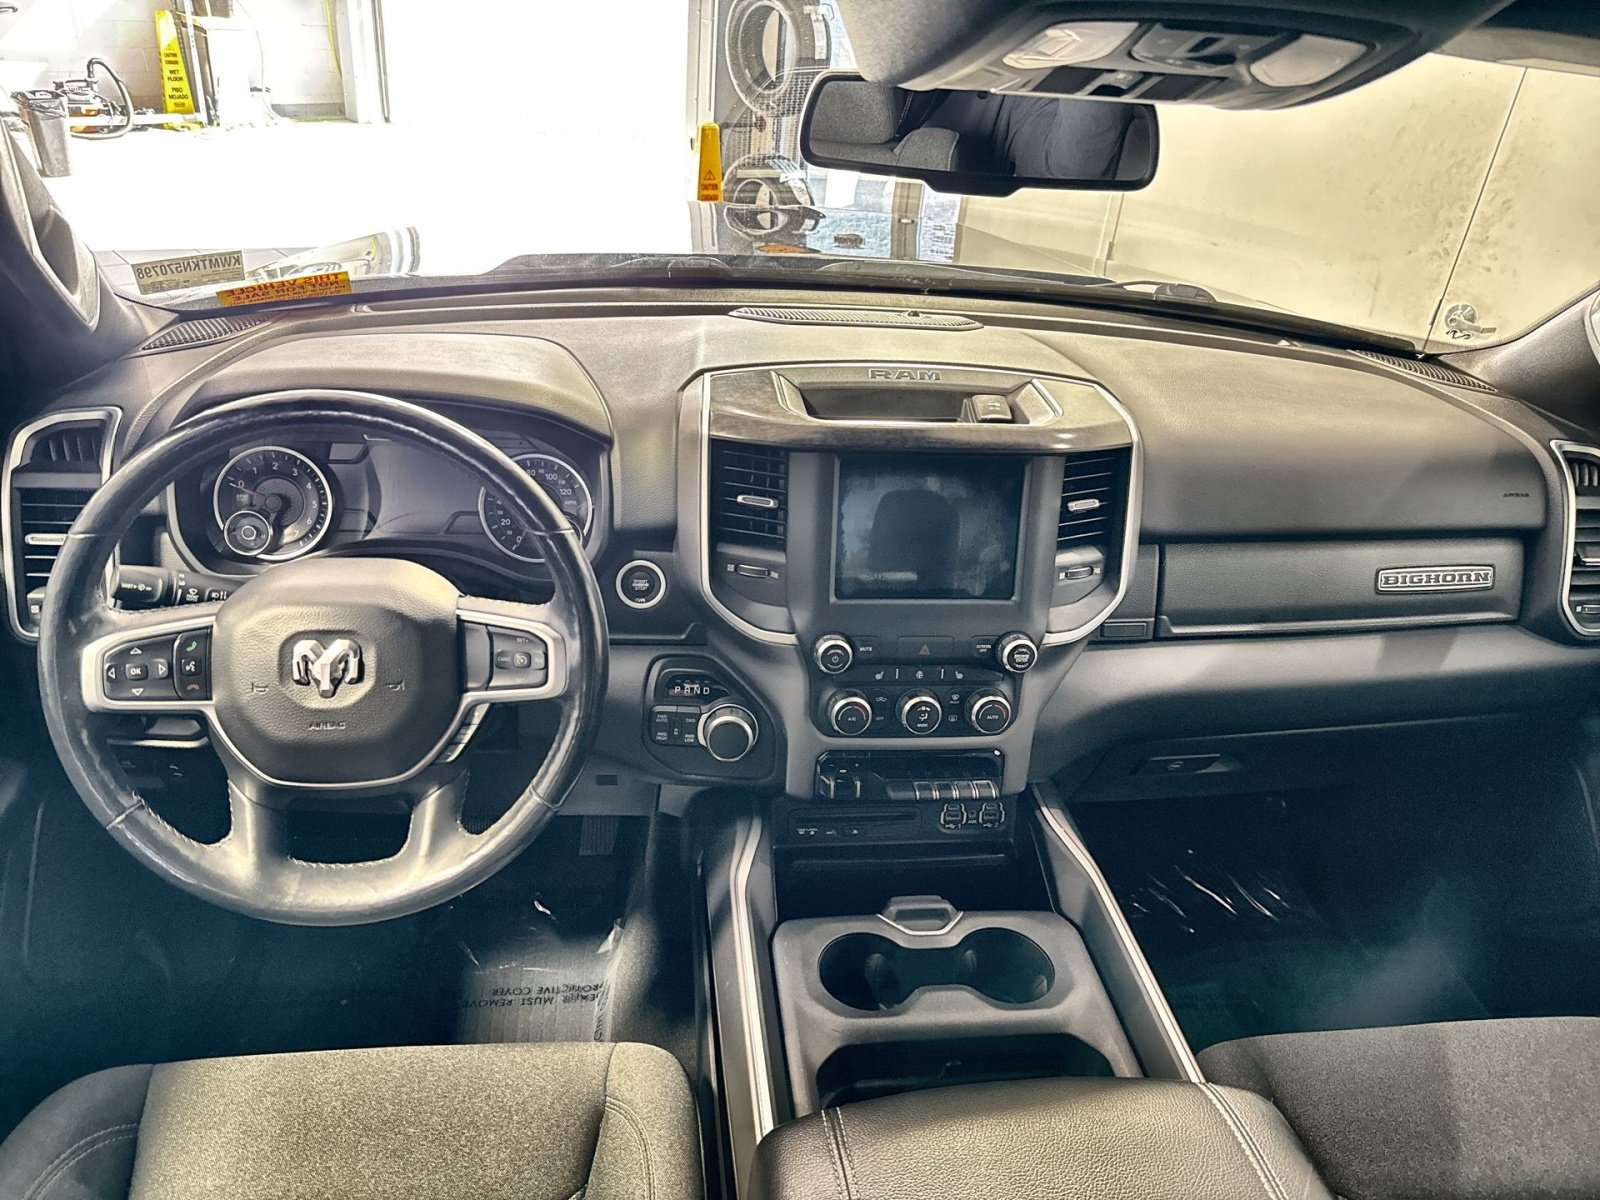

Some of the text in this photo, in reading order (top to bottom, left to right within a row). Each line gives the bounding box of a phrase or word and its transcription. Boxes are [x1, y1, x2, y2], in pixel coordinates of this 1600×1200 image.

[869, 368, 941, 381] RAM
[272, 462, 279, 470] 2
[1382, 571, 1490, 586] BIGHORN
[492, 987, 531, 996] COVER
[464, 998, 512, 1008] REMOVE
[520, 997, 554, 1005] MUST
